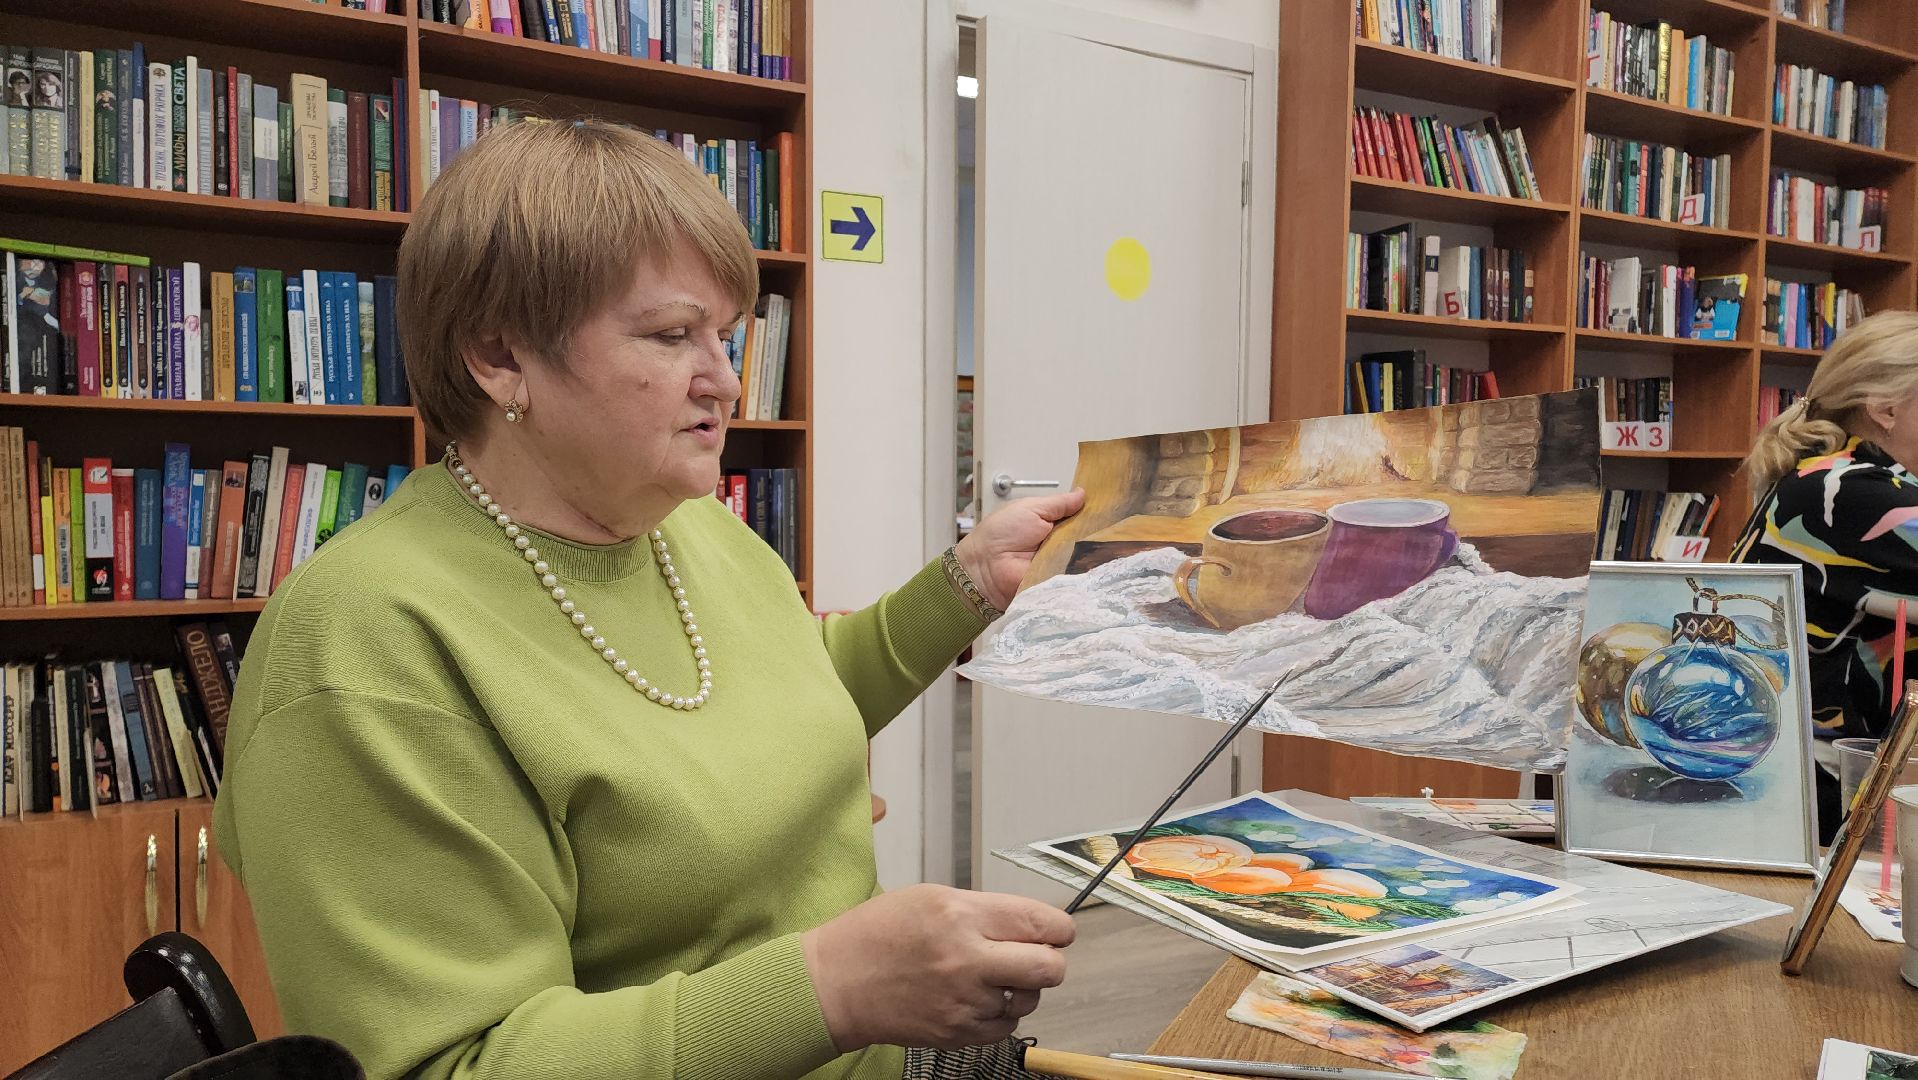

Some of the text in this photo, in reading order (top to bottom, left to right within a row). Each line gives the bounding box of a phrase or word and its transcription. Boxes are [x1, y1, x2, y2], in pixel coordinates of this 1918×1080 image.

[155, 84, 166, 113] РЮРИКА
[173, 66, 185, 104] СВЕТА
[174, 133, 185, 171] МИФЫ
[307, 134, 320, 195] Андрей Белый
[1680, 198, 1697, 222] Д
[1444, 291, 1460, 315] Б
[171, 276, 183, 397] ГЛАВНАЯ ТАЙНА ЦВЕТАЕВОЙ
[1616, 425, 1663, 447] Ж З
[1682, 540, 1703, 558] И
